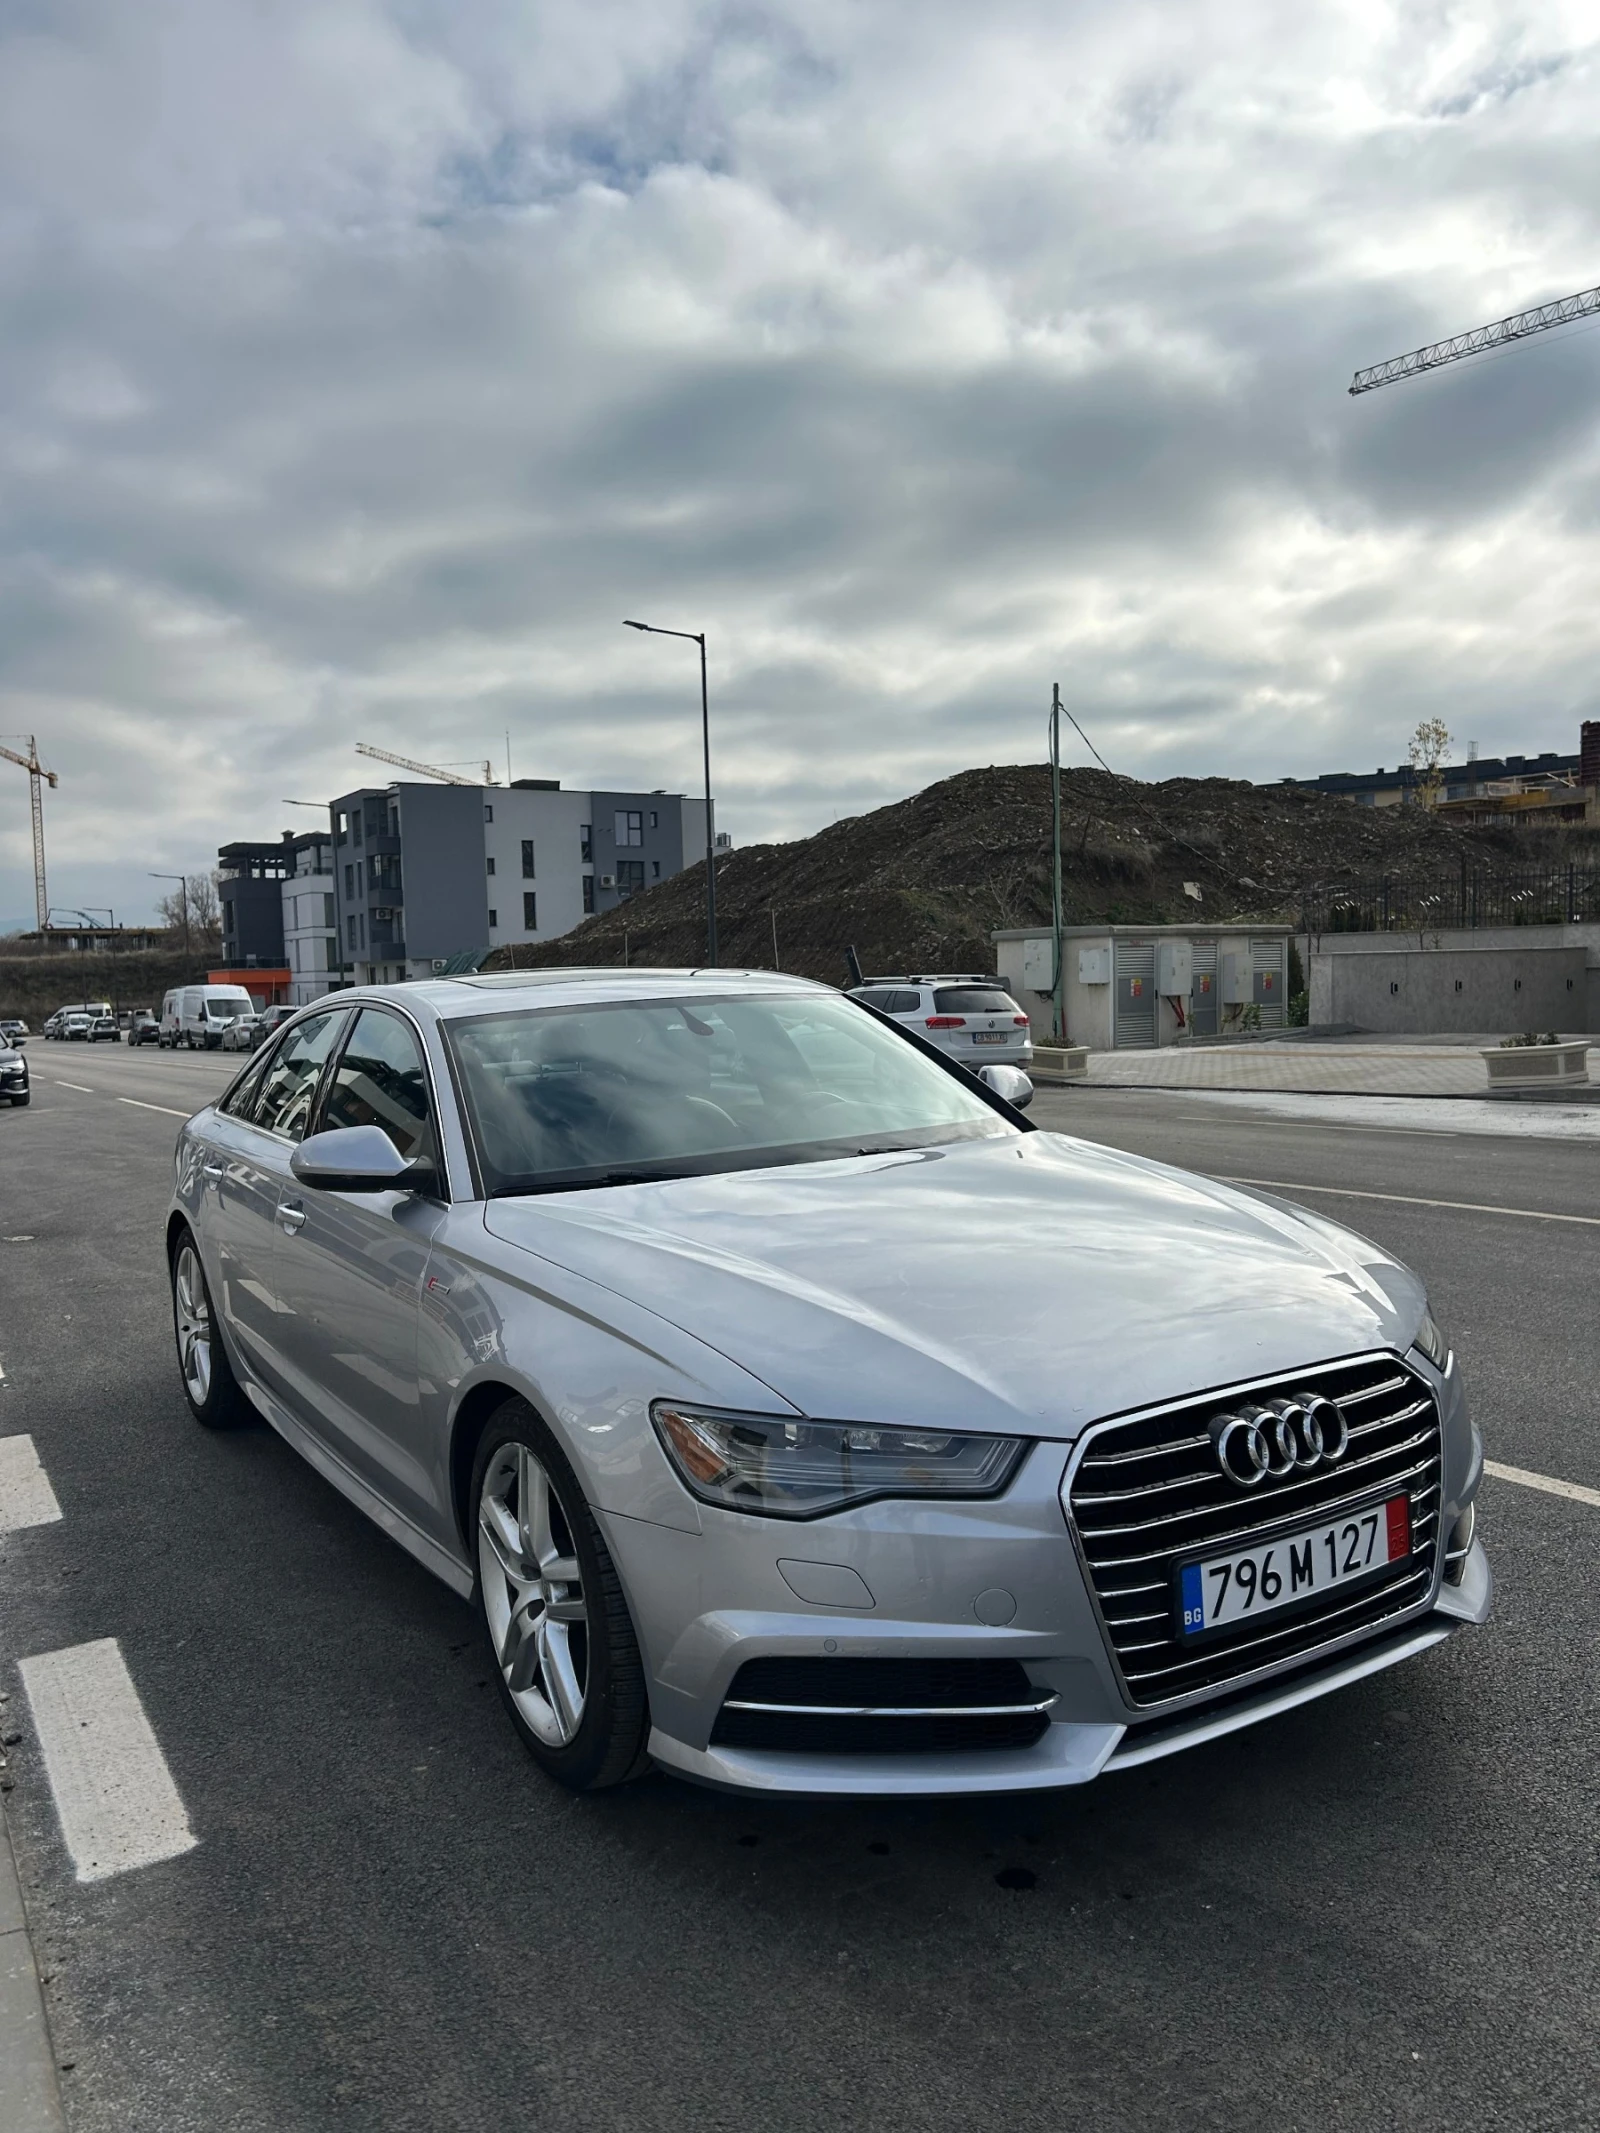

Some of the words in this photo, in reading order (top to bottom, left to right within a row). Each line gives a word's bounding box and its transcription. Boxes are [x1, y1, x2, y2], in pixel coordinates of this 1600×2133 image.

[1391, 1533, 1406, 1552] 25
[1208, 1550, 1282, 1619] 796
[1289, 1538, 1314, 1593] M
[1324, 1513, 1379, 1579] 127
[1184, 1608, 1202, 1626] BG
